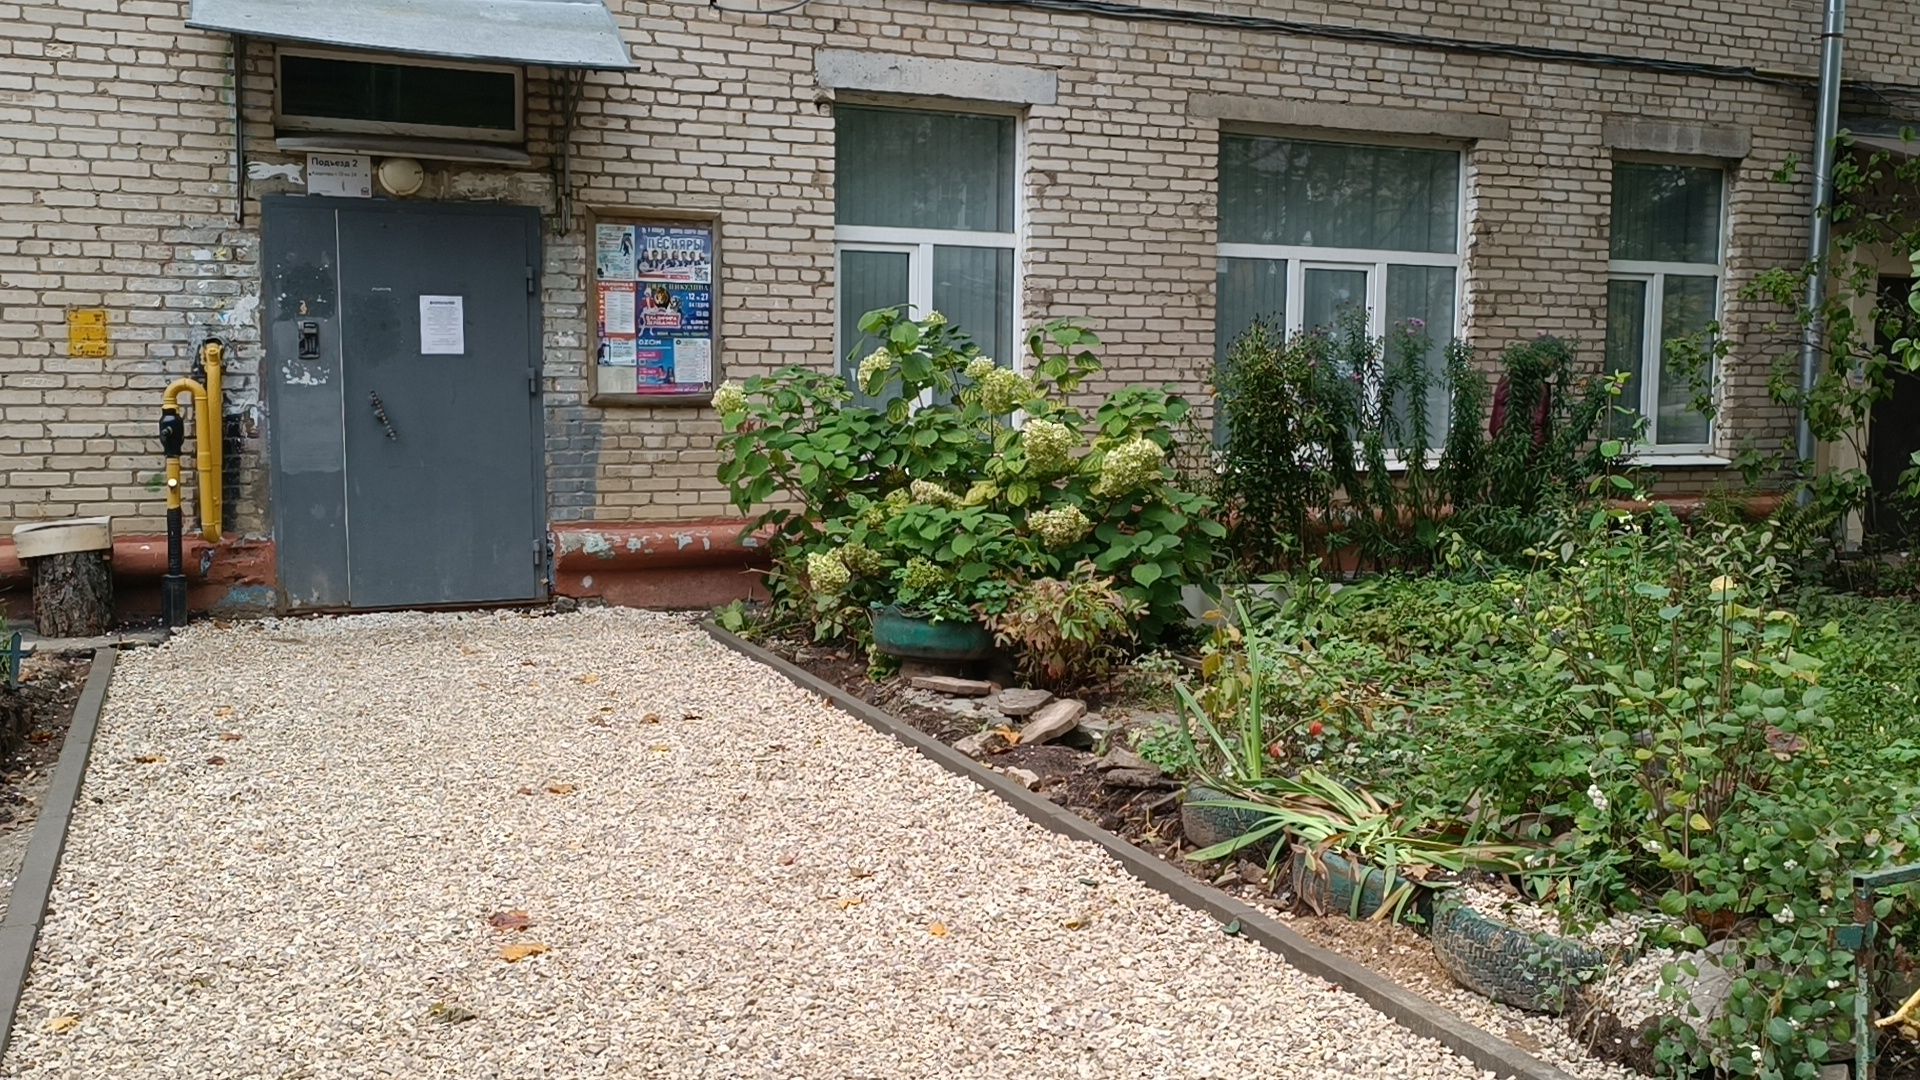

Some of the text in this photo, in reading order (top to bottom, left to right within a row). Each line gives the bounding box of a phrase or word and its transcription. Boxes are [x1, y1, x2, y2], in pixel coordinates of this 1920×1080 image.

[311, 157, 358, 168] Подъезд 2
[648, 238, 703, 251] ПЕСНЯРЫ
[688, 293, 695, 301] 12
[700, 293, 709, 301] 27
